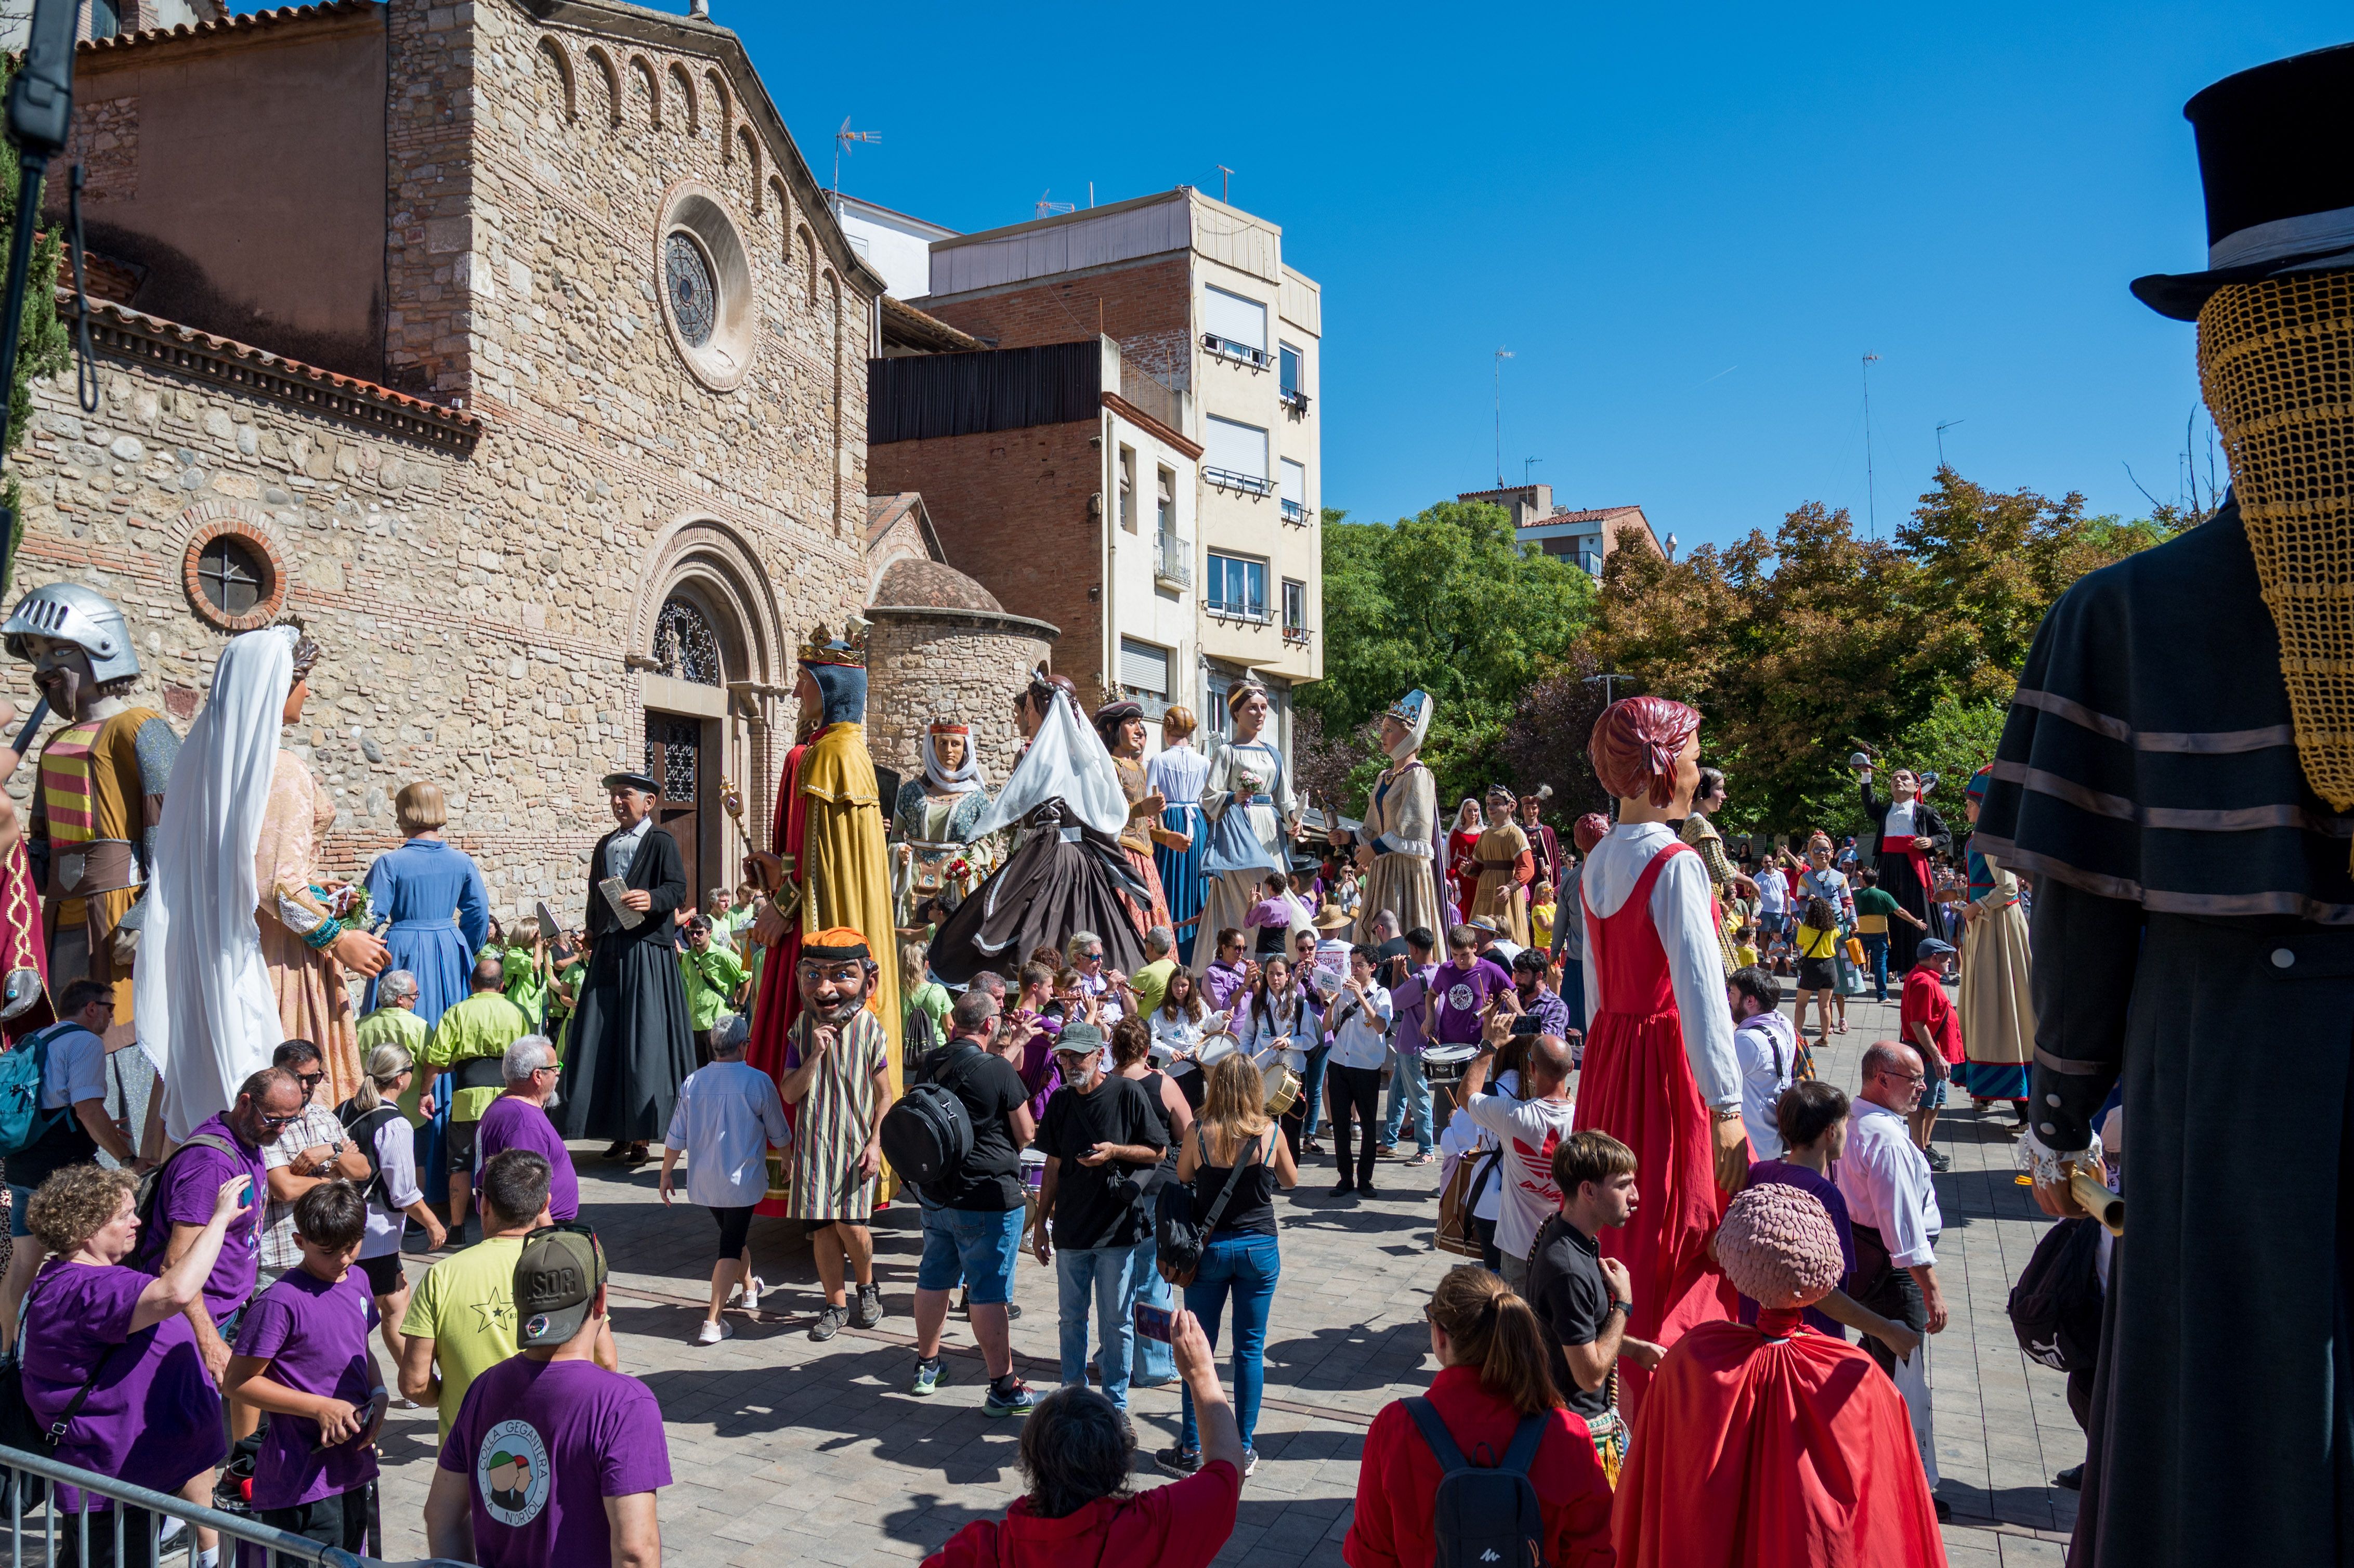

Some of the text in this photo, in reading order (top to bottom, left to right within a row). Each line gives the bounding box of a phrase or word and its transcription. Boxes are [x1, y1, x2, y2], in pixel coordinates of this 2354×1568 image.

[479, 1422, 547, 1479] COLLA GEGANTERA
[484, 1493, 543, 1525] CA N'ORIOL
